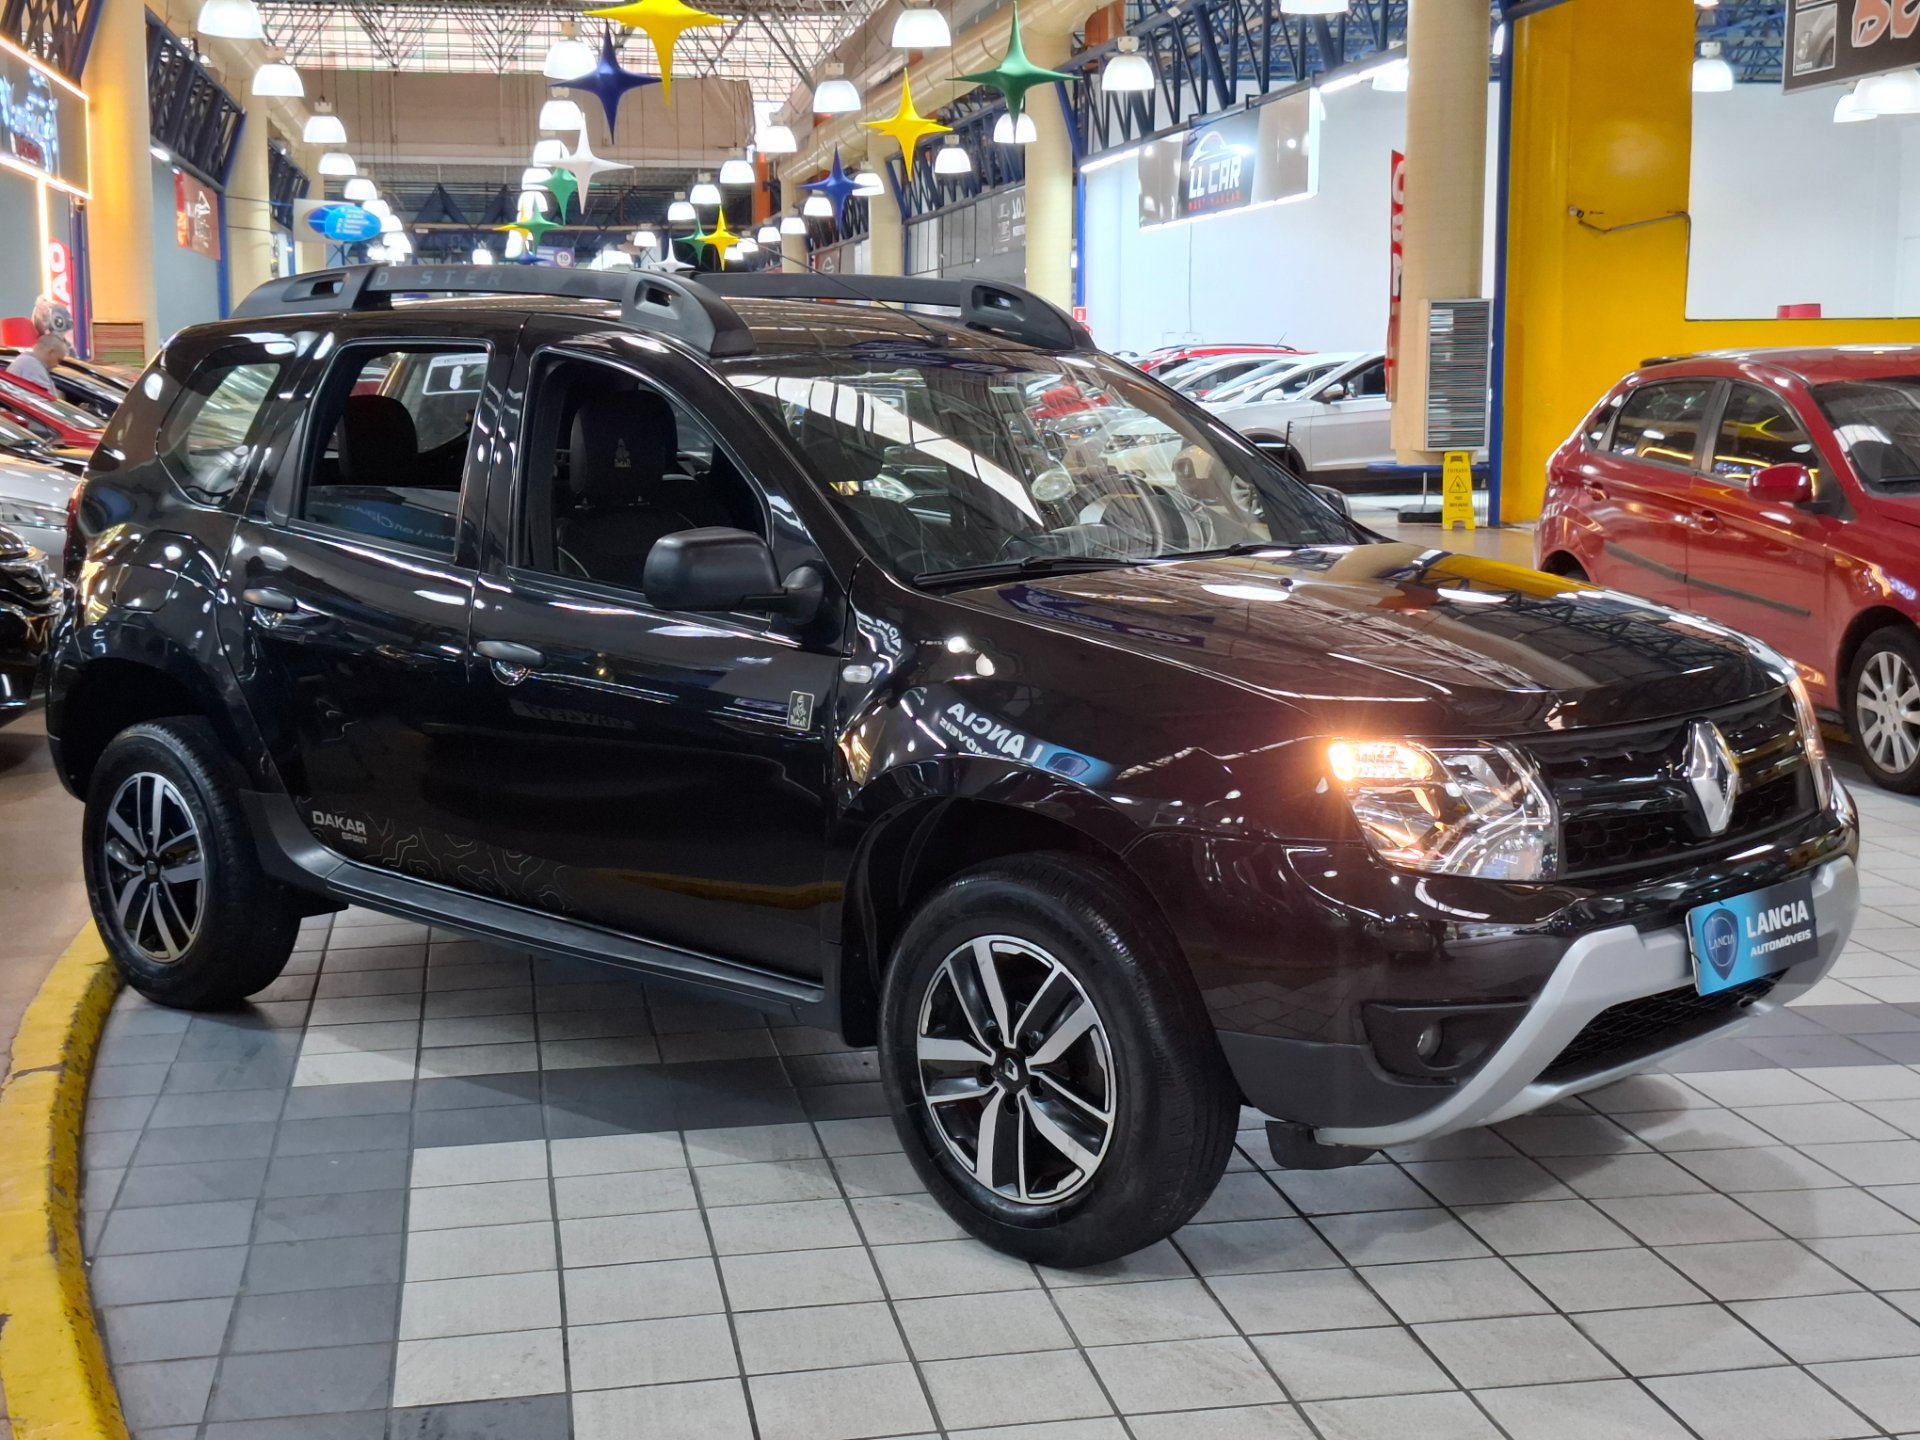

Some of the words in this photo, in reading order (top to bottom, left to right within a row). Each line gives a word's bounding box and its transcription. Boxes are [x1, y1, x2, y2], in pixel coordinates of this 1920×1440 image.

[1188, 166, 1206, 199] LL
[1207, 156, 1242, 194] CAR
[375, 270, 503, 287] DSTER
[312, 810, 367, 835] DAKAR
[1745, 899, 1810, 938] LANCIA
[1708, 933, 1736, 951] LANCIA
[1750, 928, 1812, 958] AUTOMÓVEIS
